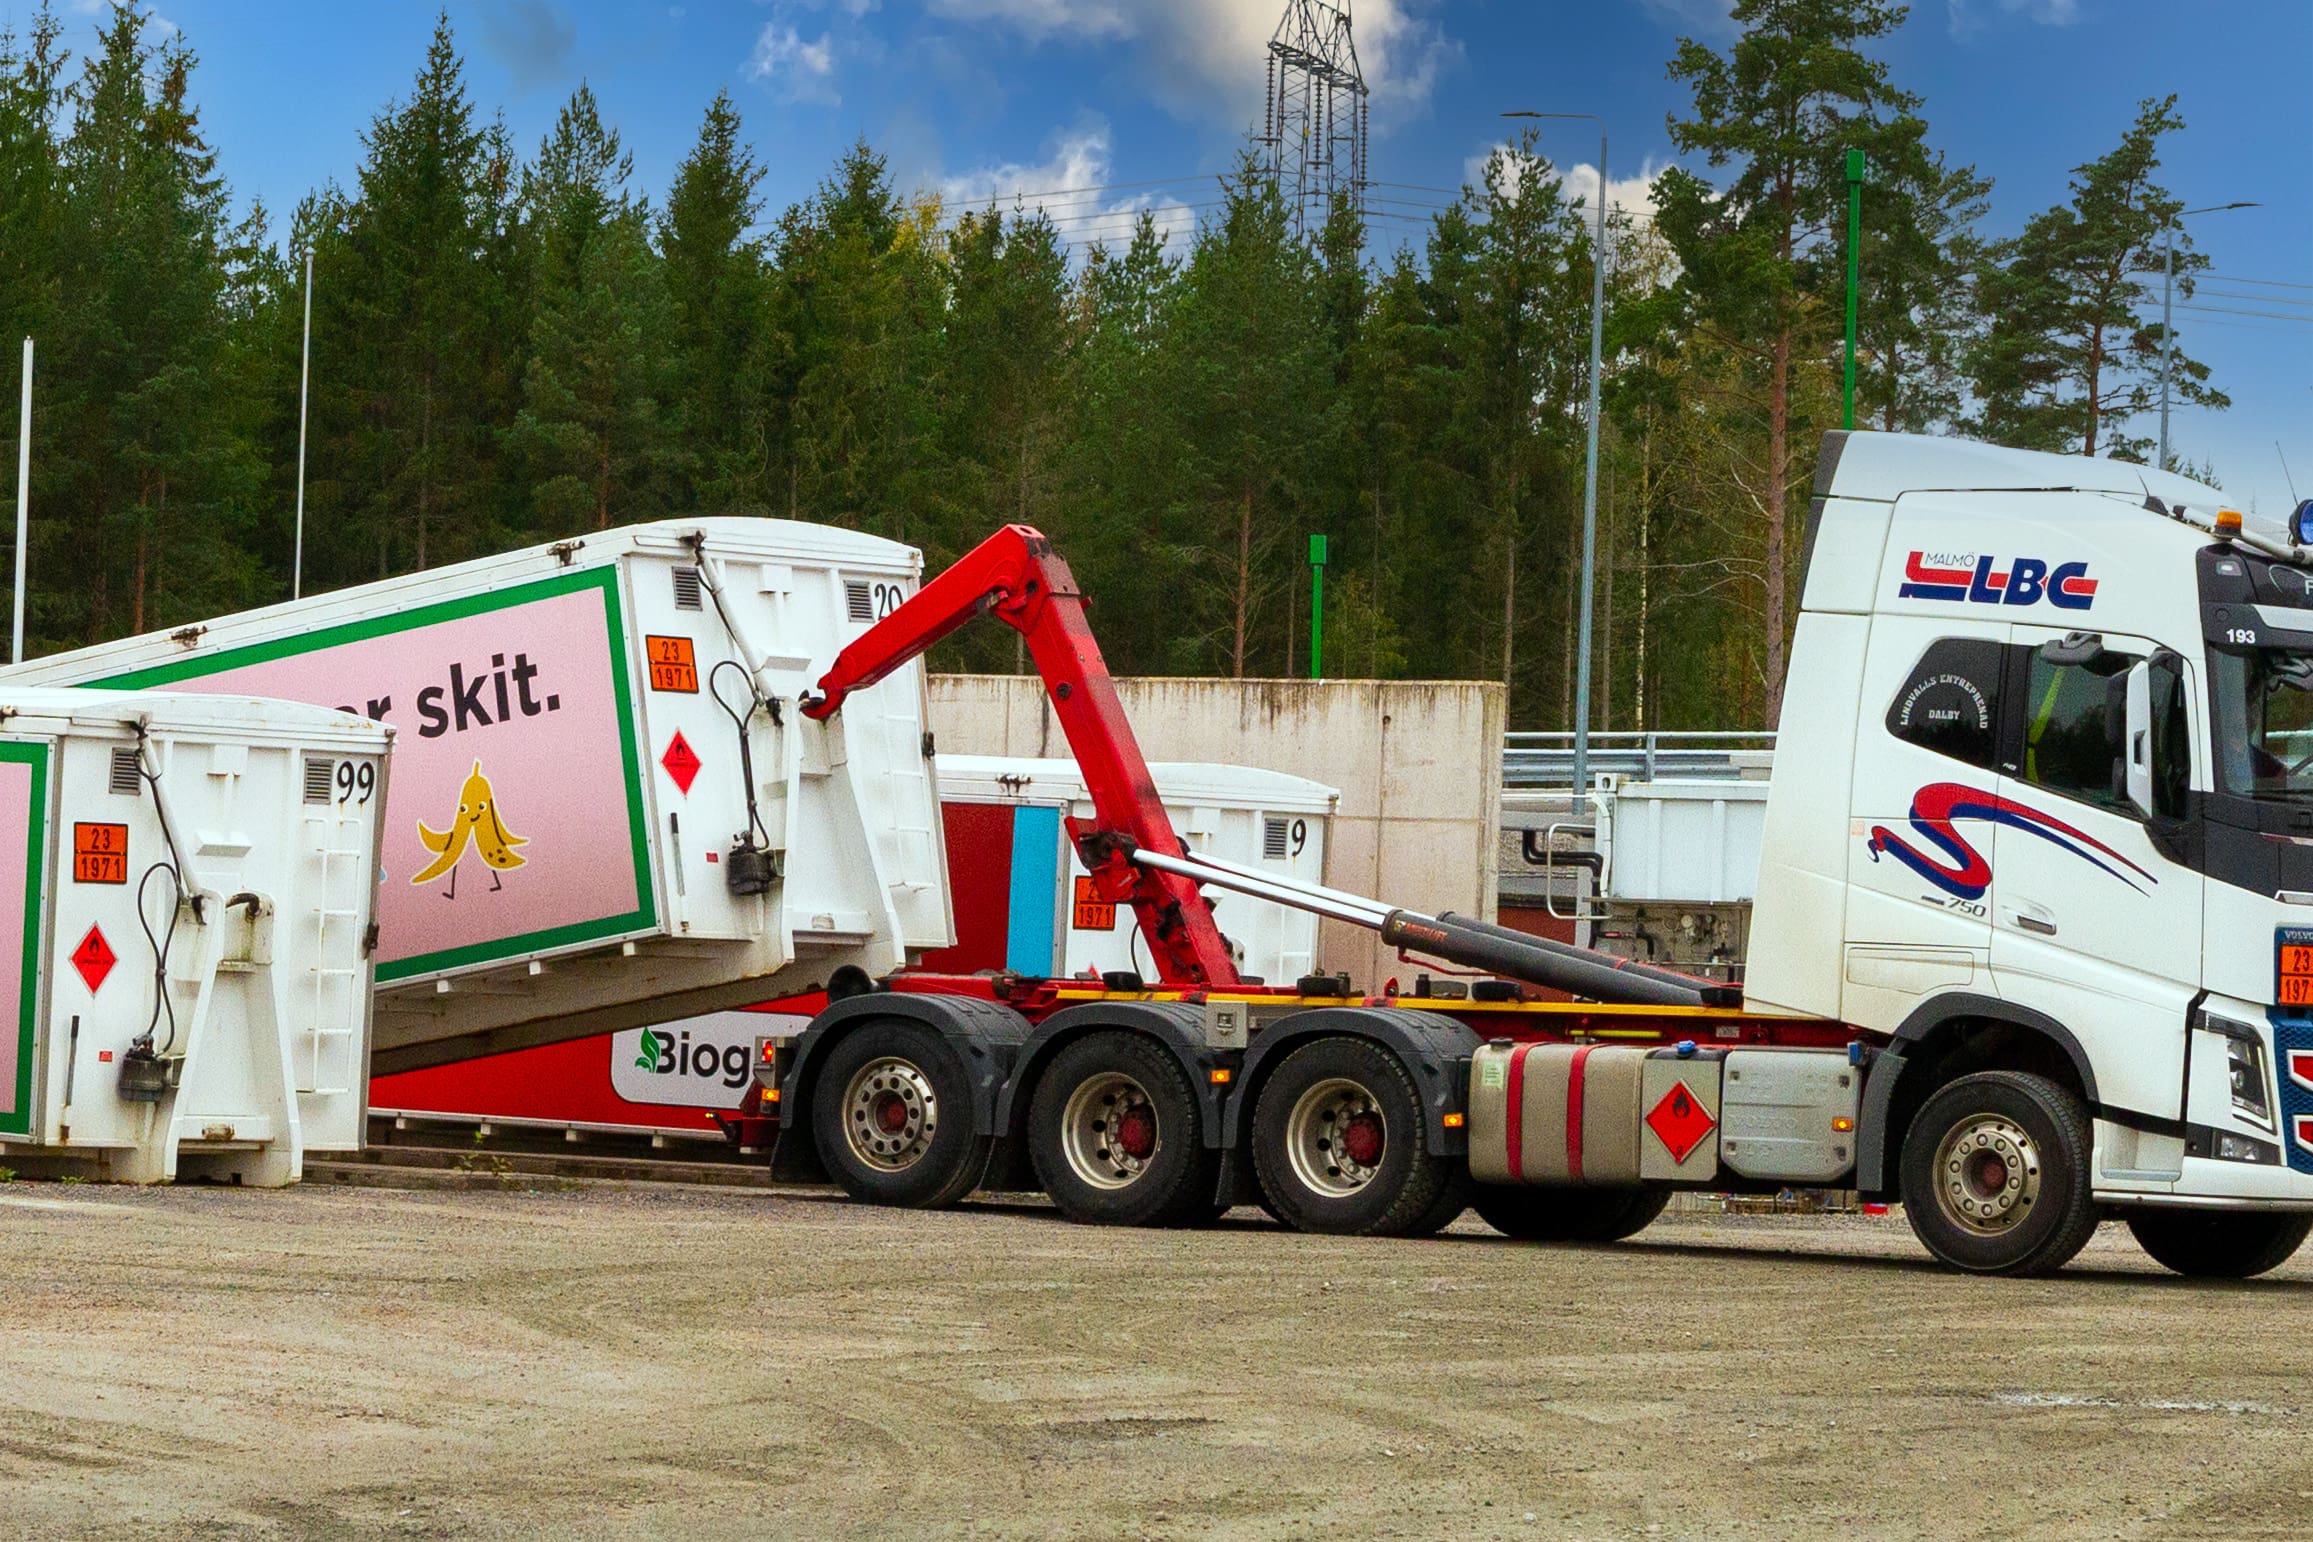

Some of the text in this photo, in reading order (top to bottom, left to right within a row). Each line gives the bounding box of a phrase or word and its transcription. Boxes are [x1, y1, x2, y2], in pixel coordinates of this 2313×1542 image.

[1925, 552, 1975, 567] MALMÖ
[1969, 555, 2094, 610] LBC
[2226, 629, 2256, 644] 193
[662, 641, 680, 661] 23
[656, 668, 693, 689] 1971
[335, 653, 561, 738] r skit.
[1900, 676, 1937, 726] LINDVALLS
[1928, 709, 1961, 721] DALBY
[337, 761, 375, 804] 99
[91, 828, 111, 850] 23
[1291, 818, 1306, 857] 9
[81, 857, 121, 879] 1971
[1080, 906, 1111, 926] 1971
[1948, 897, 1987, 917] 750
[2294, 949, 2310, 972] 23
[2286, 979, 2313, 1002] 197
[650, 1031, 751, 1089] Biog
